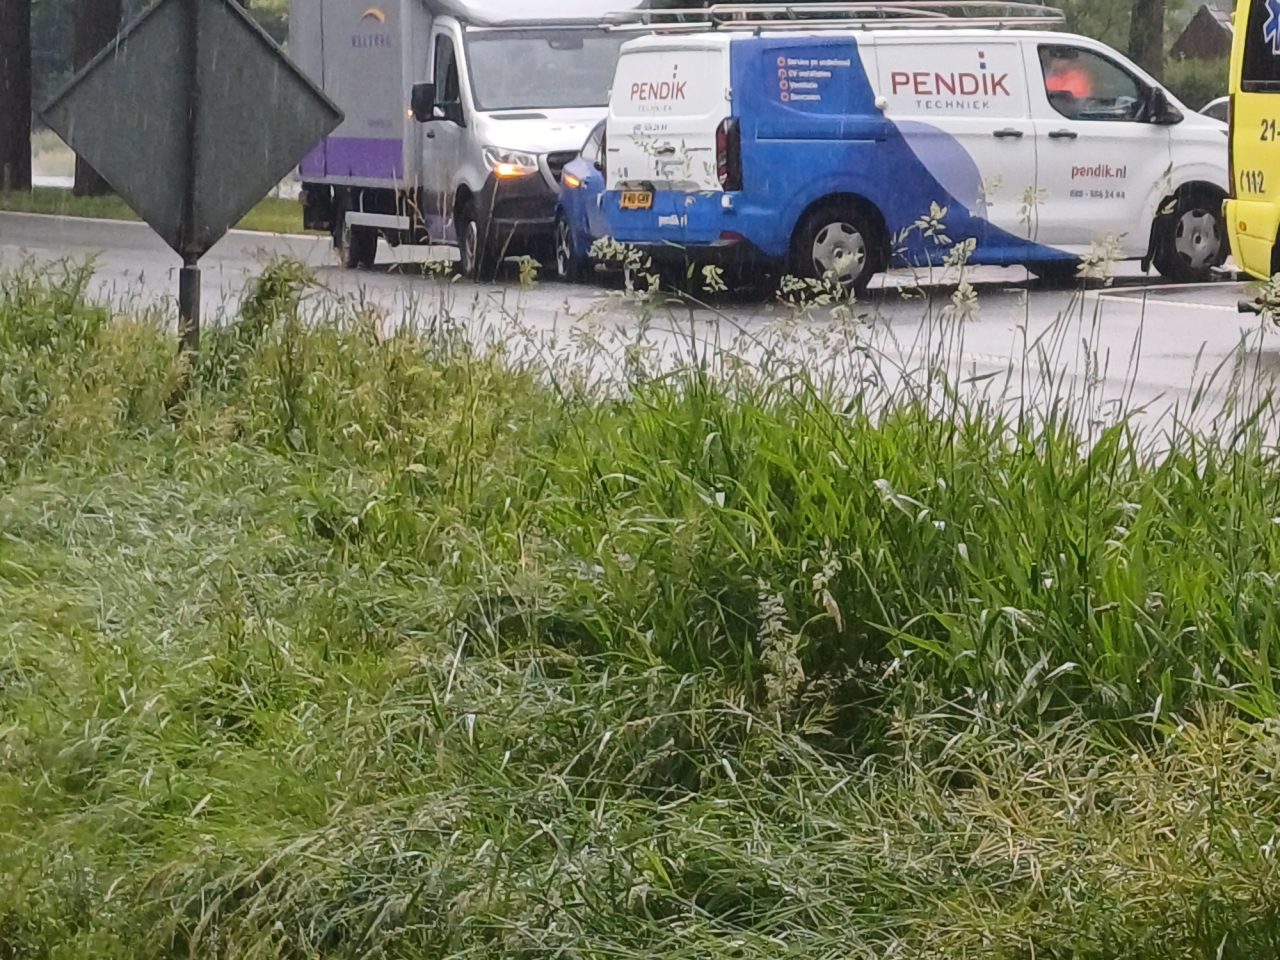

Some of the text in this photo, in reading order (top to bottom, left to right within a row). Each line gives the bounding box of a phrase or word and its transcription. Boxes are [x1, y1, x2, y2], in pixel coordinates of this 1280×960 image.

[916, 100, 990, 110] TECHNIEK
[1071, 164, 1127, 180] pendik.nl
[1246, 170, 1266, 194] 112
